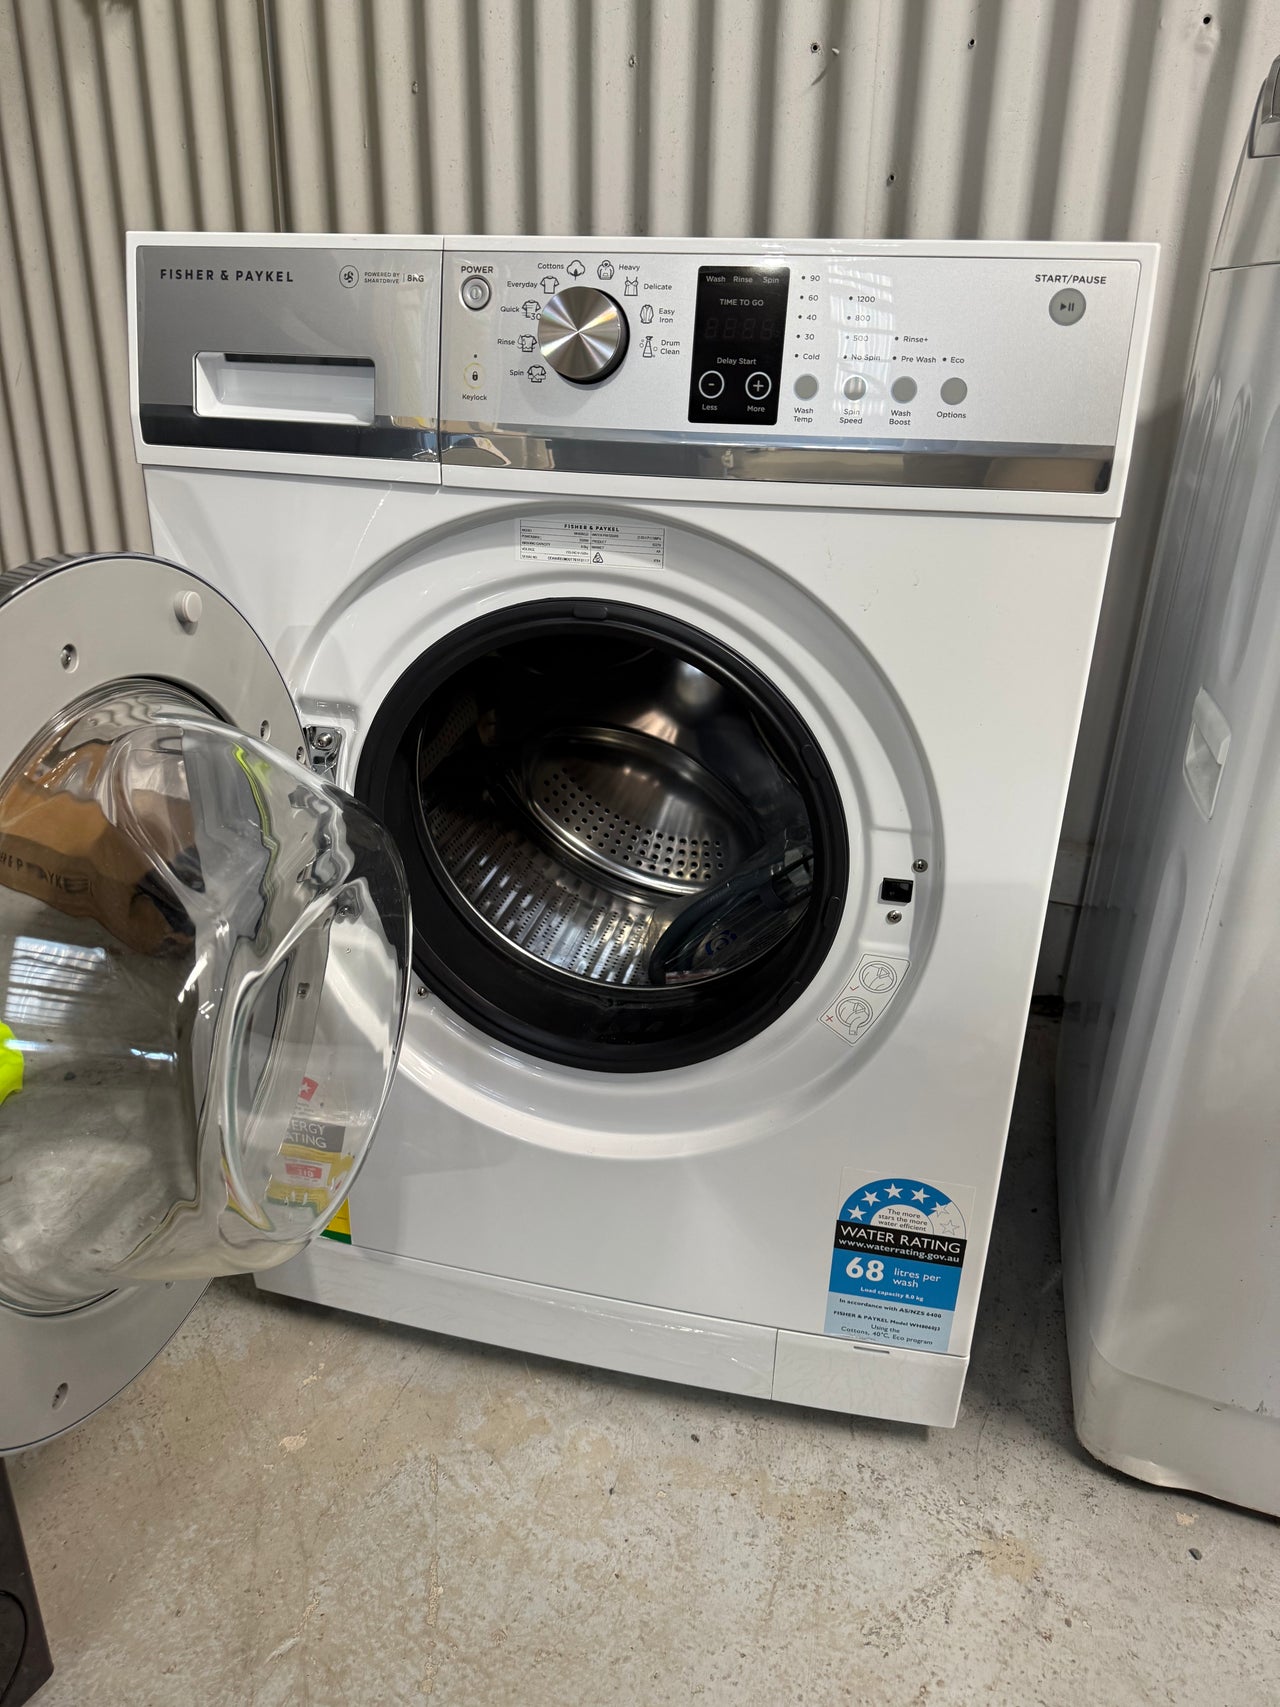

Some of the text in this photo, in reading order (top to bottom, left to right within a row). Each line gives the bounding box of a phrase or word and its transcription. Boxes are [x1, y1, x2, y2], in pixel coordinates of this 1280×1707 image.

[461, 266, 494, 274] POWER
[537, 262, 564, 270] Cottons
[618, 264, 641, 272] Heavy
[160, 268, 294, 283] FISHER & PAYKEL
[706, 275, 726, 283] Wash
[733, 275, 753, 283] Rinse
[1035, 274, 1107, 284] START/PAUSE
[763, 276, 780, 284] Spin
[507, 280, 538, 289] Everyday
[808, 294, 819, 302] 60
[500, 306, 520, 314] Quick
[658, 308, 675, 316] Easy
[804, 333, 815, 341] 30
[497, 338, 515, 346] Rinse
[717, 357, 737, 365] Delay
[803, 353, 820, 361] Cold
[863, 354, 881, 363] Spin
[915, 356, 937, 364] Wash
[509, 369, 525, 377] Spin
[462, 394, 488, 402] Keylock
[702, 404, 718, 412] Less
[747, 405, 766, 413] More
[794, 407, 814, 415] Wash
[844, 409, 860, 417] Spin
[891, 410, 911, 418] Wash
[936, 411, 967, 420] Options
[793, 416, 813, 424] Temp
[839, 417, 863, 426] Speed
[889, 418, 911, 426] Boost
[291, 1119, 326, 1136] ERGY
[286, 1131, 327, 1149] ATING
[888, 1208, 921, 1220] The more
[878, 1214, 928, 1226] stars the more
[878, 1220, 927, 1232] water efficient
[840, 1224, 961, 1254] WATER RATING
[838, 1238, 960, 1263] www.waterrating.gov.au
[845, 1257, 885, 1282] 68
[894, 1267, 942, 1283] litres per
[892, 1278, 919, 1289] wash
[860, 1286, 877, 1294] Load
[877, 1290, 904, 1299] capacity
[847, 1300, 882, 1309] accordance
[884, 1304, 898, 1312] with
[899, 1307, 925, 1316] AS/NZS
[833, 1310, 856, 1318] FISHER
[863, 1315, 889, 1323] PAYKEL
[871, 1324, 889, 1333] Using
[841, 1325, 870, 1336] Cottons,
[906, 1337, 933, 1346] program
